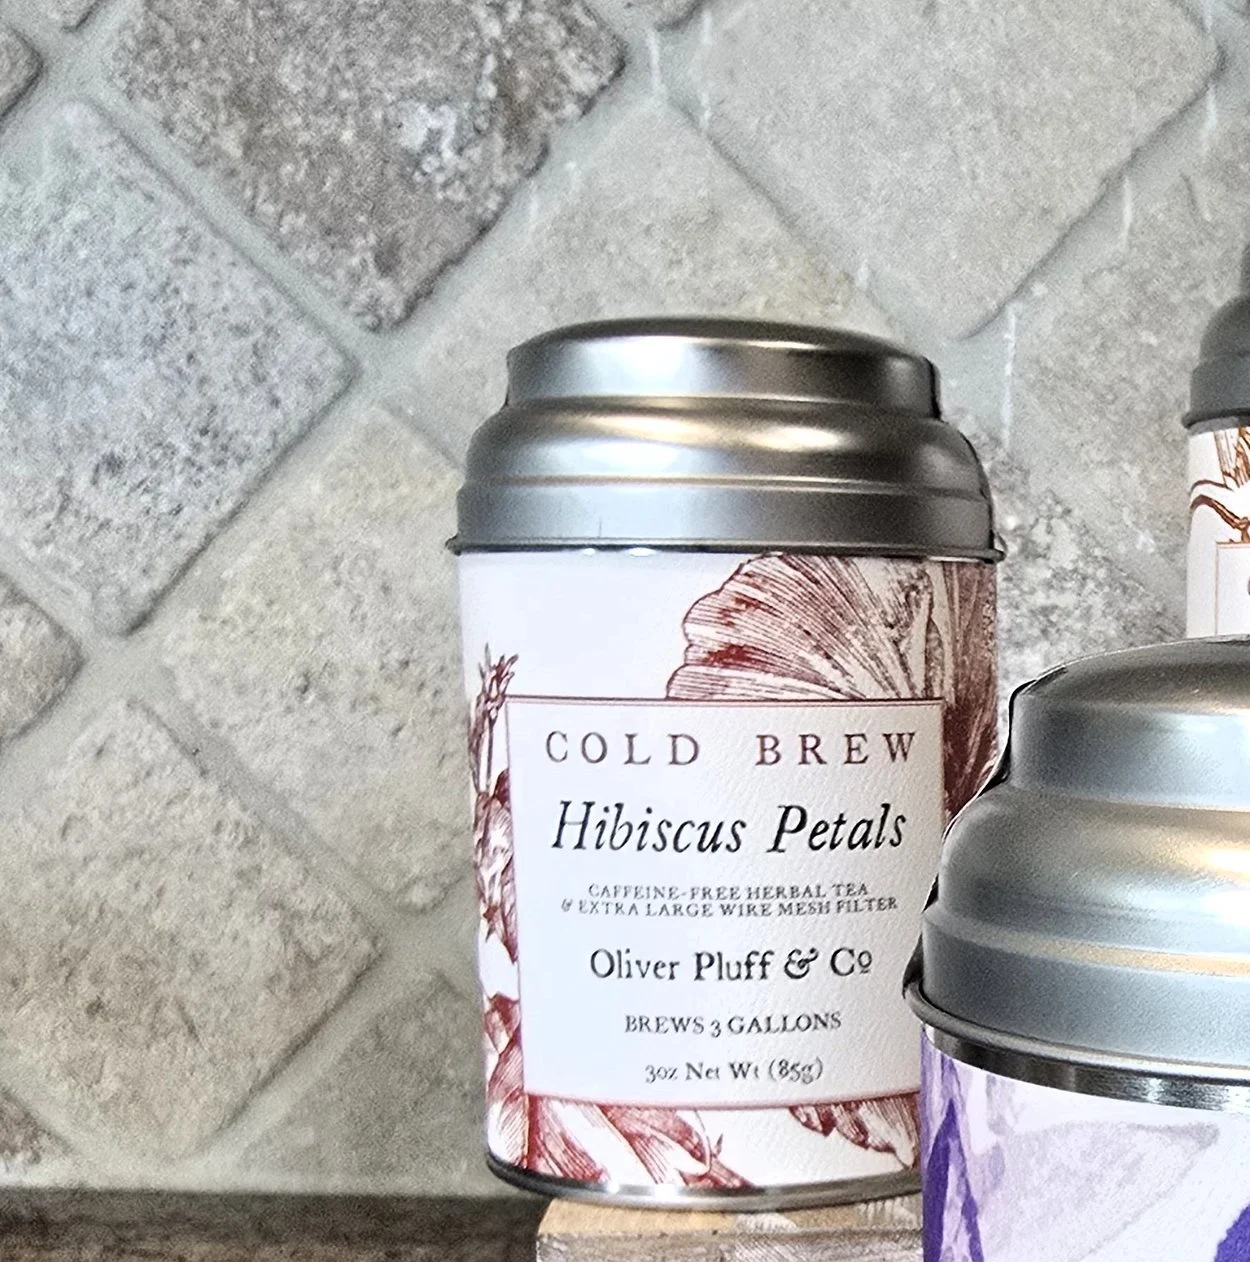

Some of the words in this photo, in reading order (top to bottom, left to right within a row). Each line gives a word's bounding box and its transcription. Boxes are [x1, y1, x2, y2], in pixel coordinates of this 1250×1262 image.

[546, 730, 698, 766] COLD
[755, 731, 916, 766] BREW
[551, 800, 747, 854] Hibiscus
[766, 802, 907, 853] Petals
[588, 883, 741, 900] CAFFEINE-FREE
[745, 883, 826, 899] HERBAL
[831, 883, 869, 897] TEA
[578, 901, 639, 916] EXTRA
[645, 902, 713, 917] LARGE
[720, 903, 772, 916] WIRE
[778, 901, 831, 916] MESH
[836, 897, 897, 914] FILTER
[589, 948, 680, 980] Oliver
[694, 950, 774, 981] Pluff
[784, 948, 819, 980] &
[624, 1015, 704, 1034] BREWS
[710, 1020, 721, 1038] 3
[728, 1012, 841, 1034] GALLONS
[644, 1064, 678, 1083] 3oz
[685, 1062, 720, 1080] Net
[729, 1062, 759, 1080] Wt
[768, 1058, 823, 1083] (85g)
